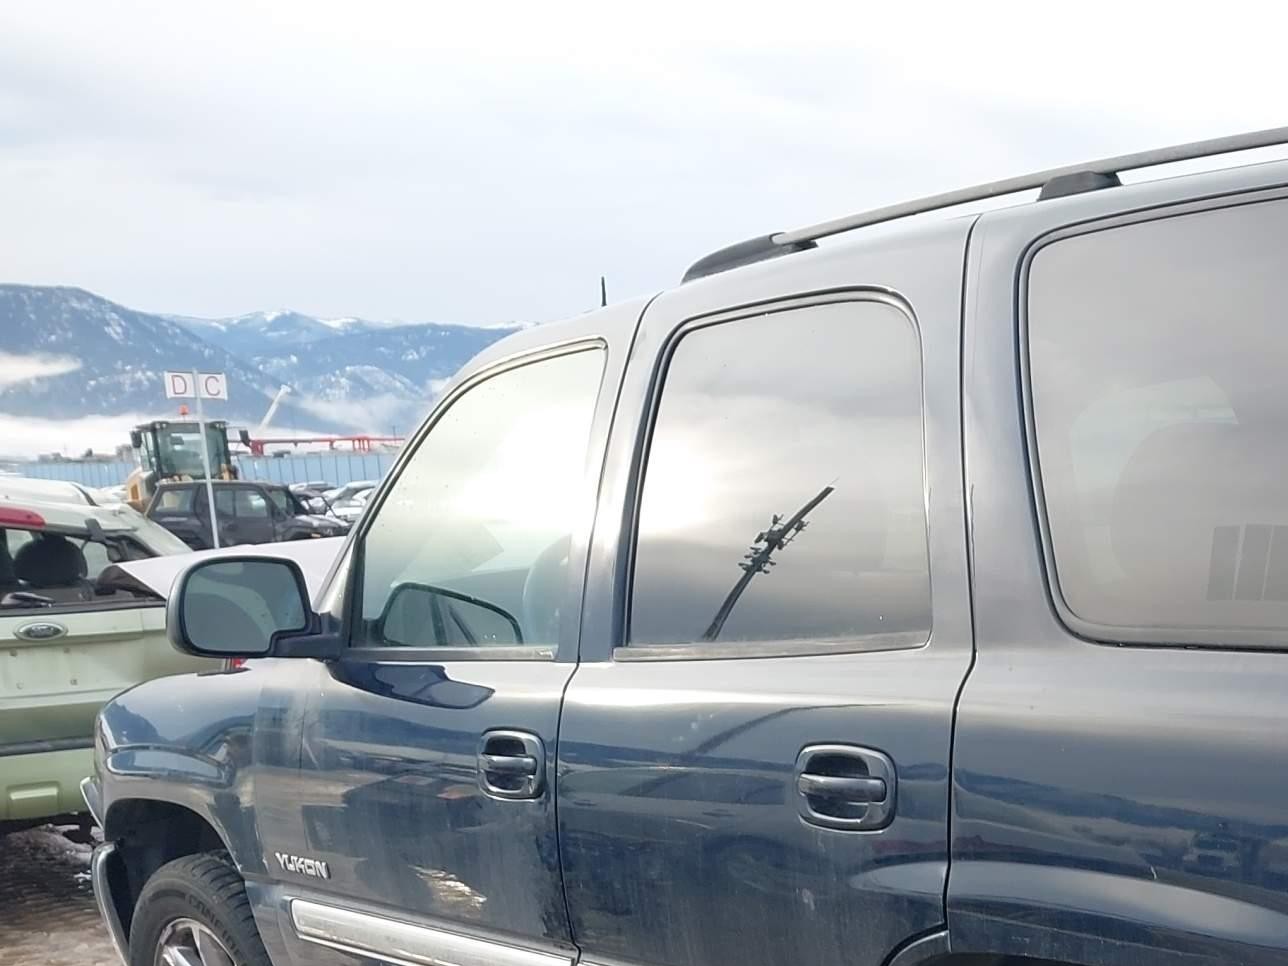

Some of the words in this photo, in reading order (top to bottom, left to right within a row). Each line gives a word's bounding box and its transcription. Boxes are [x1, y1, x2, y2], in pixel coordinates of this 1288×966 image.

[171, 374, 187, 395] D
[205, 376, 221, 396] C
[274, 852, 332, 880] YUKON
